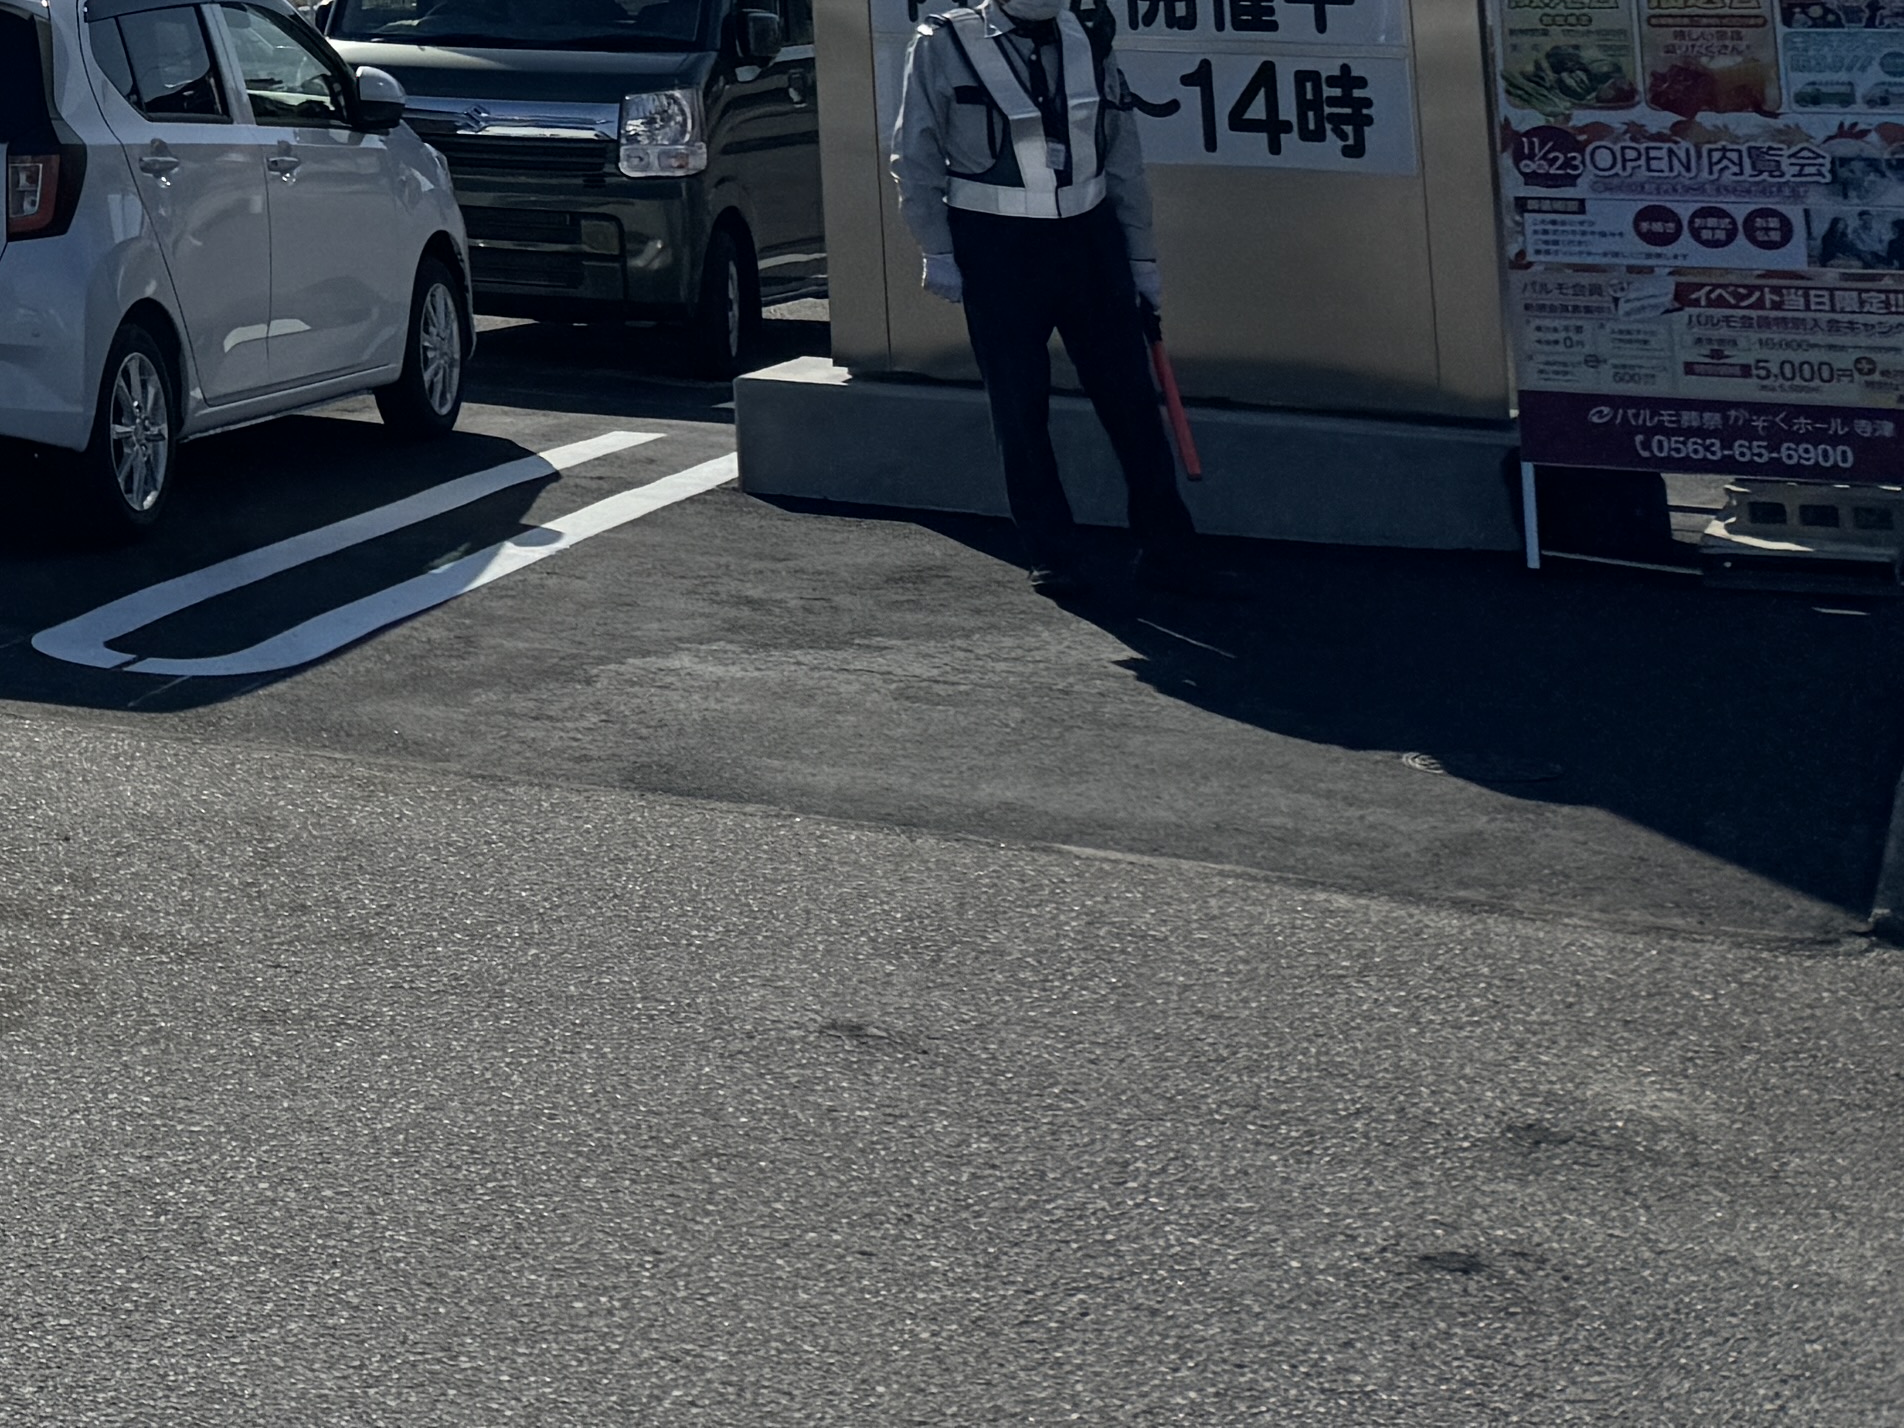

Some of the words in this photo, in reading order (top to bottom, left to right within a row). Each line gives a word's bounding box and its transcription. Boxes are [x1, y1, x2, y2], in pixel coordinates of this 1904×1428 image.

[1589, 144, 1692, 174] OPEN
[1707, 145, 1827, 179] 内覧会
[1651, 435, 1855, 469] 0563-65-6900
